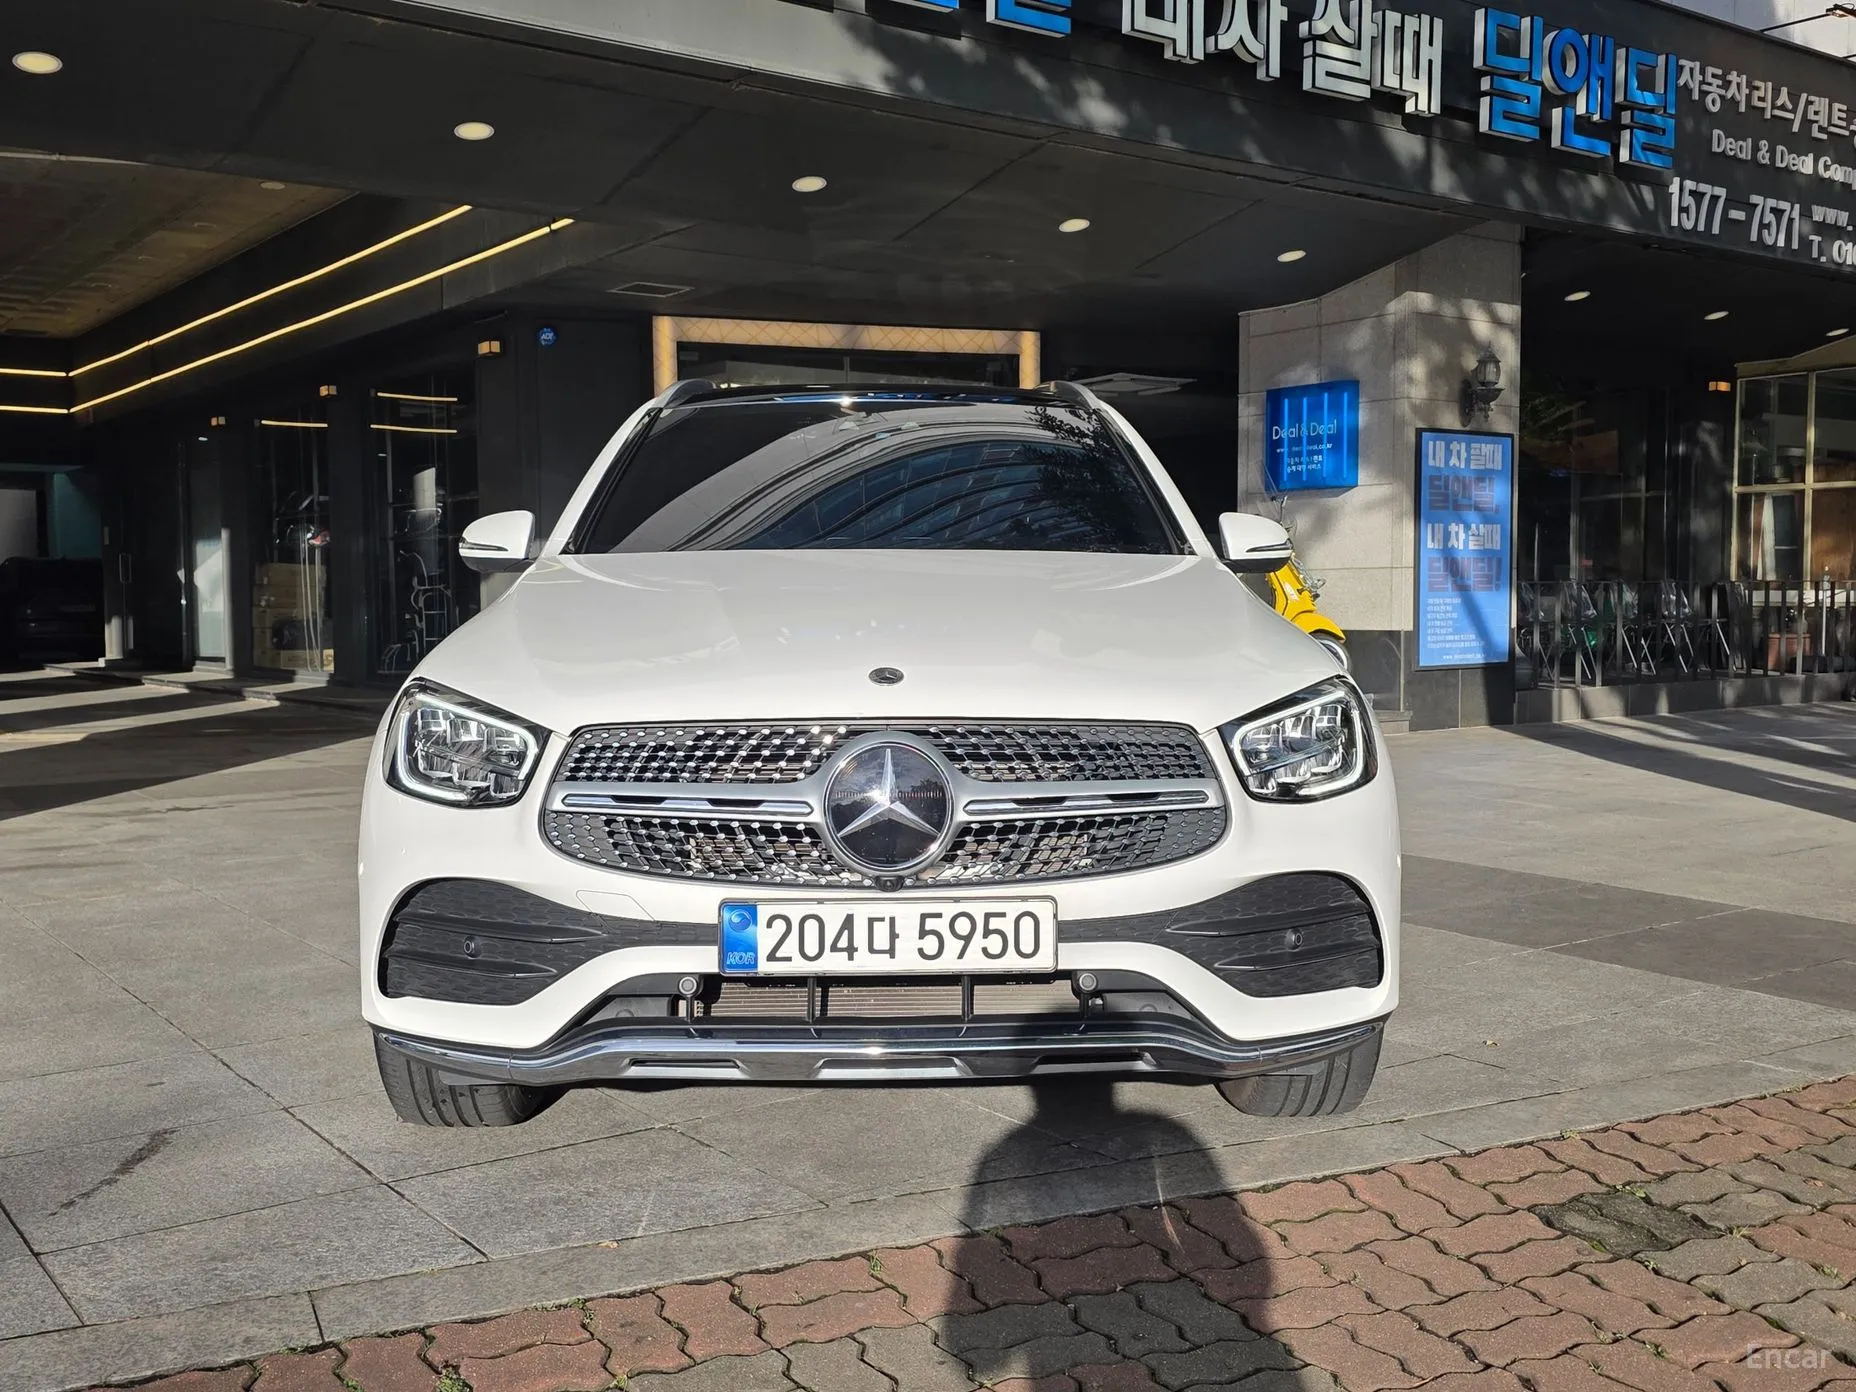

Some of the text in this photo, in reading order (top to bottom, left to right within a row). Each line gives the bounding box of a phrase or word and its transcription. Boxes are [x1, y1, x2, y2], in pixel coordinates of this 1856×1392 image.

[1474, 7, 1677, 169] 딜앤딜
[1711, 128, 1752, 161] Deal
[1756, 139, 1771, 165] &
[1775, 144, 1814, 175] Deal
[1668, 176, 1800, 250] 1577-7571
[1272, 423, 1299, 440] Deal
[1310, 419, 1337, 436] Deal
[726, 951, 756, 965] KOR
[765, 910, 1041, 962] 204다 5950
